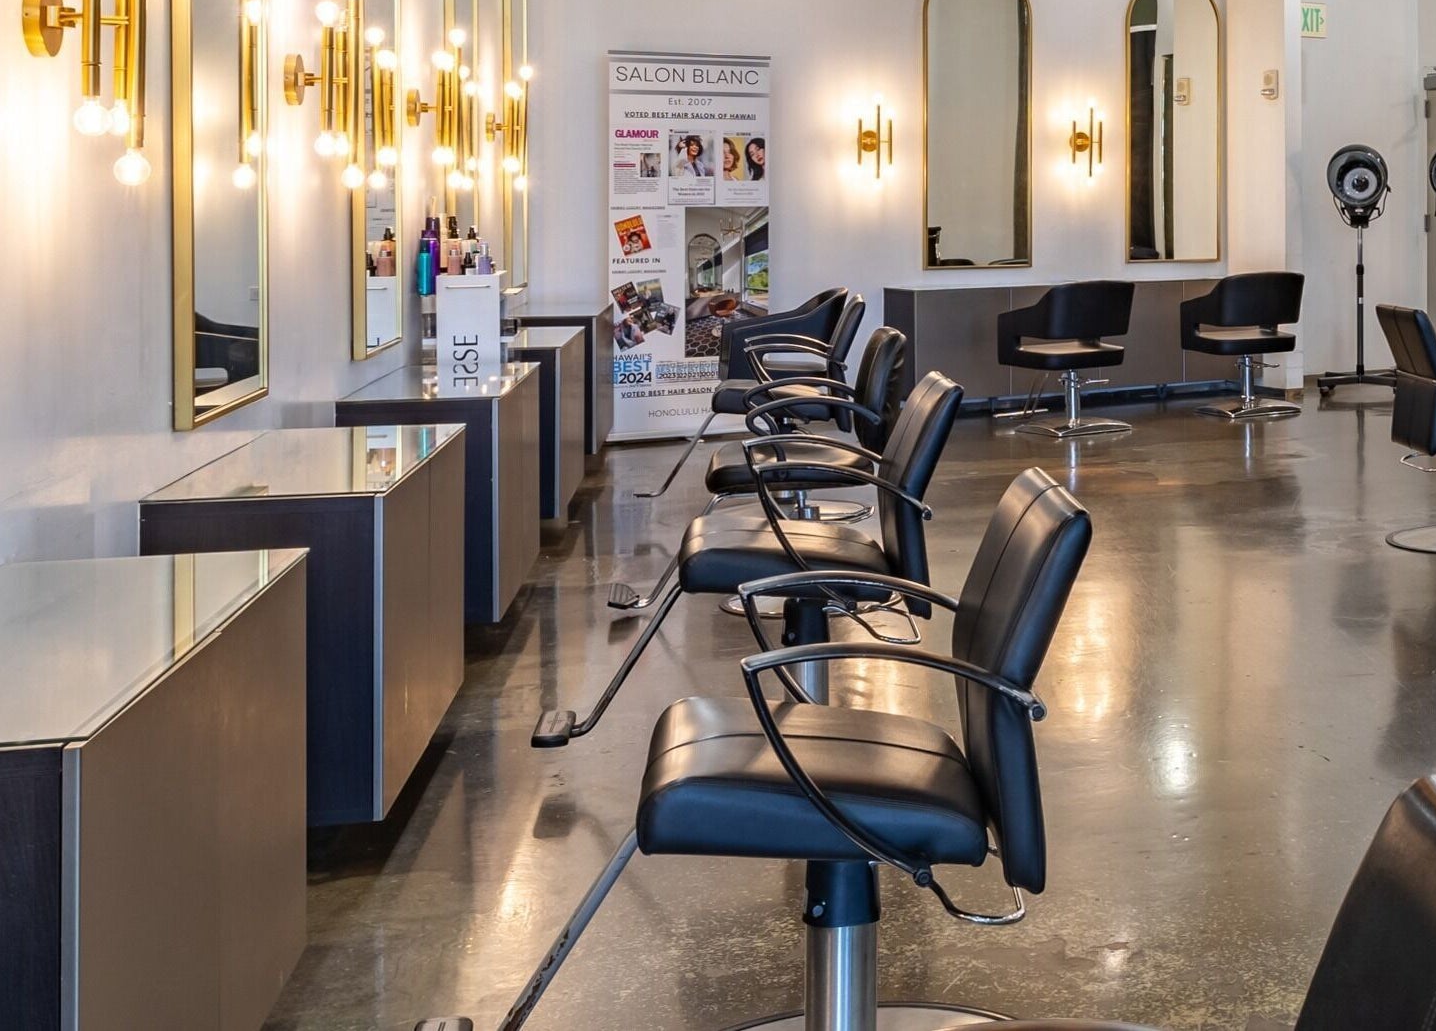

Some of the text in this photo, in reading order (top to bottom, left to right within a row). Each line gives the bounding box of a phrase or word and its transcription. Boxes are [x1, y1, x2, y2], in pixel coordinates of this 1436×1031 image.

[1301, 7, 1321, 32] XIT
[616, 66, 760, 85] SALON BLANC
[668, 97, 713, 106] Est. 2007
[691, 112, 717, 120] SALON
[615, 129, 659, 139] GLAMOUR
[613, 361, 652, 372] BEST
[619, 372, 652, 384] 2024
[648, 408, 699, 418] HONOLULU
